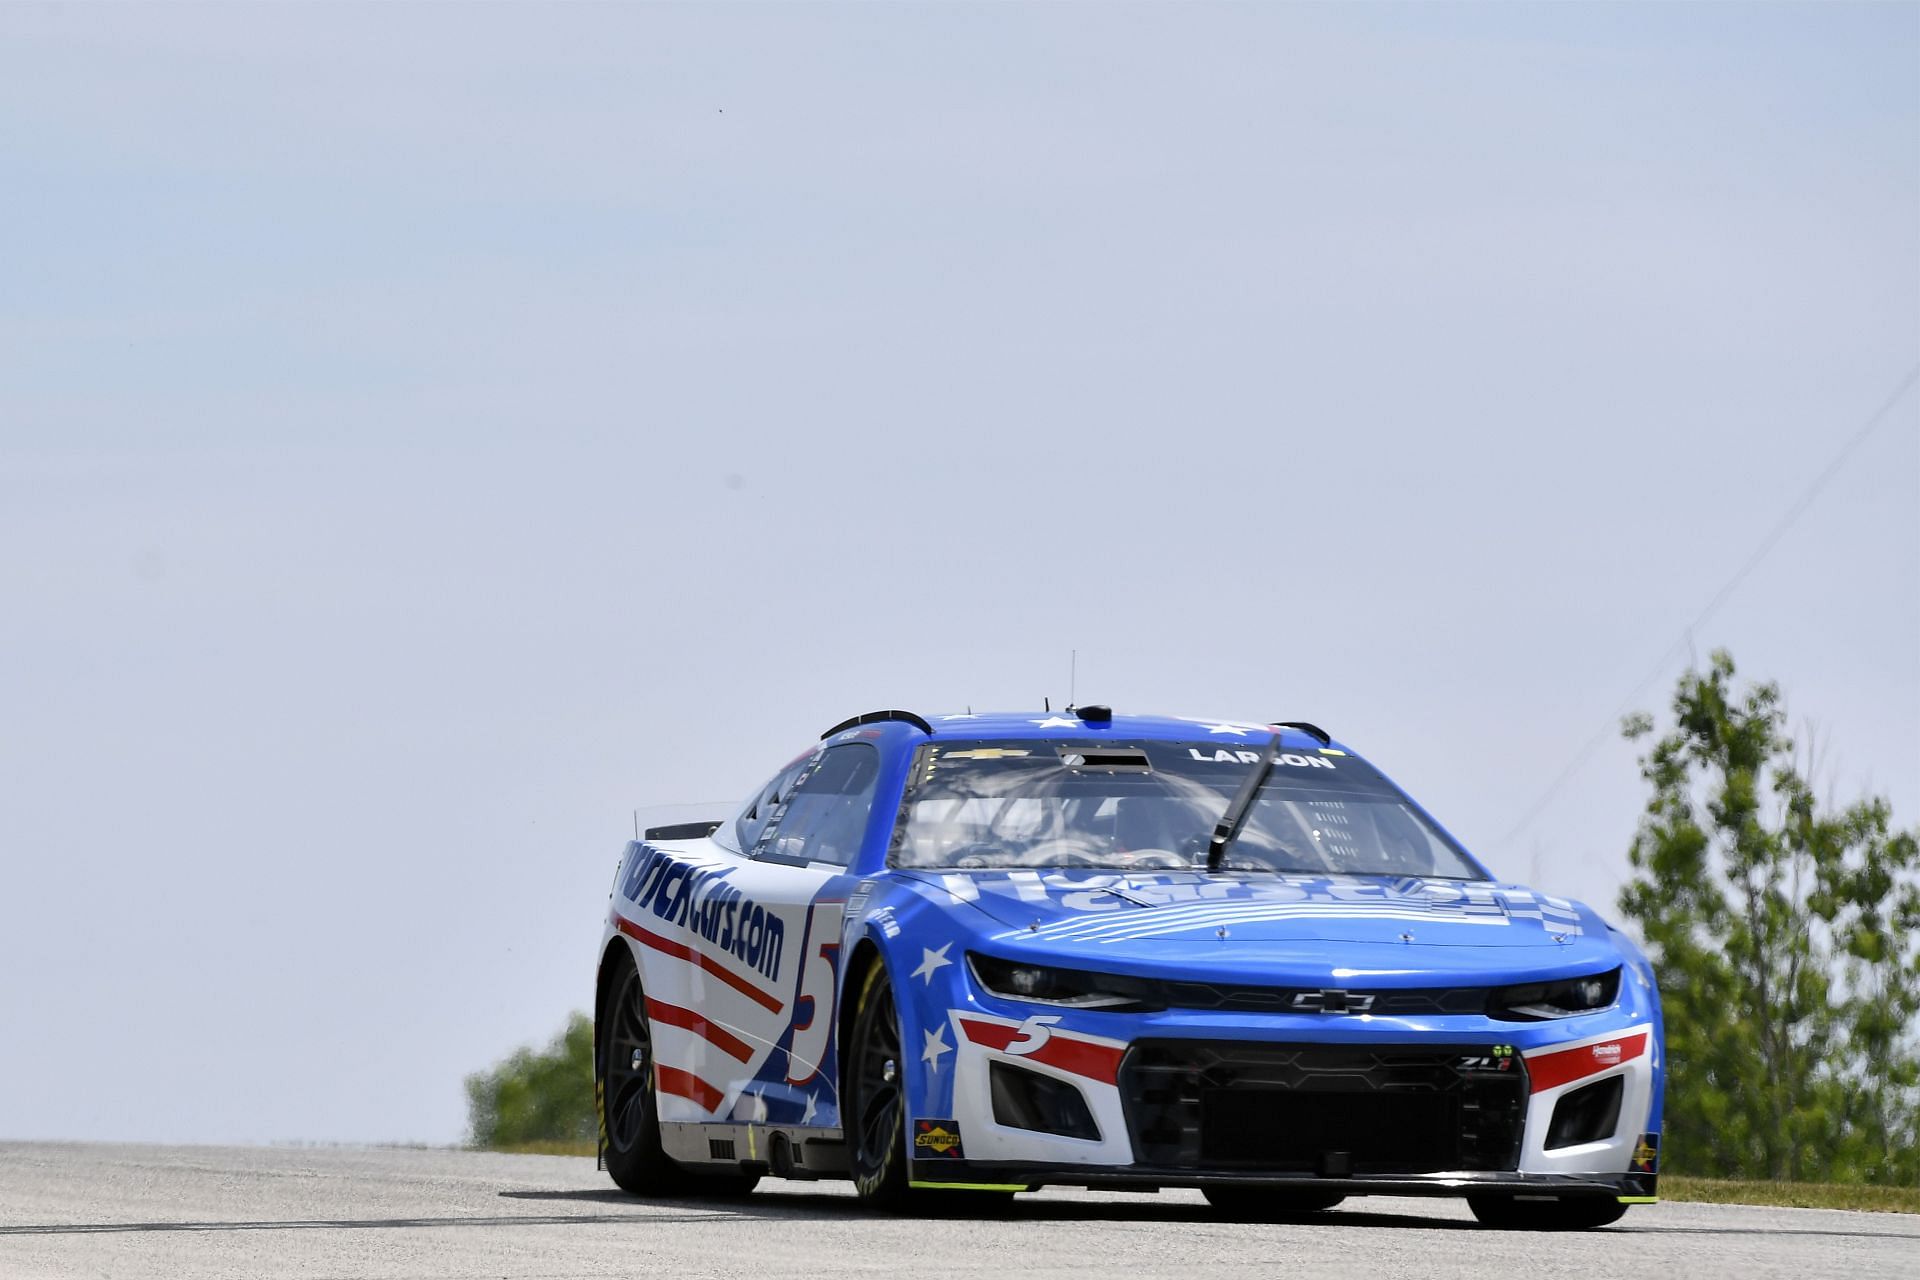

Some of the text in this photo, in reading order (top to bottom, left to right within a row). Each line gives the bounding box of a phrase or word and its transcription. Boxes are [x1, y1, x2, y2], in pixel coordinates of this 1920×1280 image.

[783, 898, 846, 1087] 5
[1003, 1015, 1063, 1055] 5
[918, 1134, 958, 1145] SUNOCO
